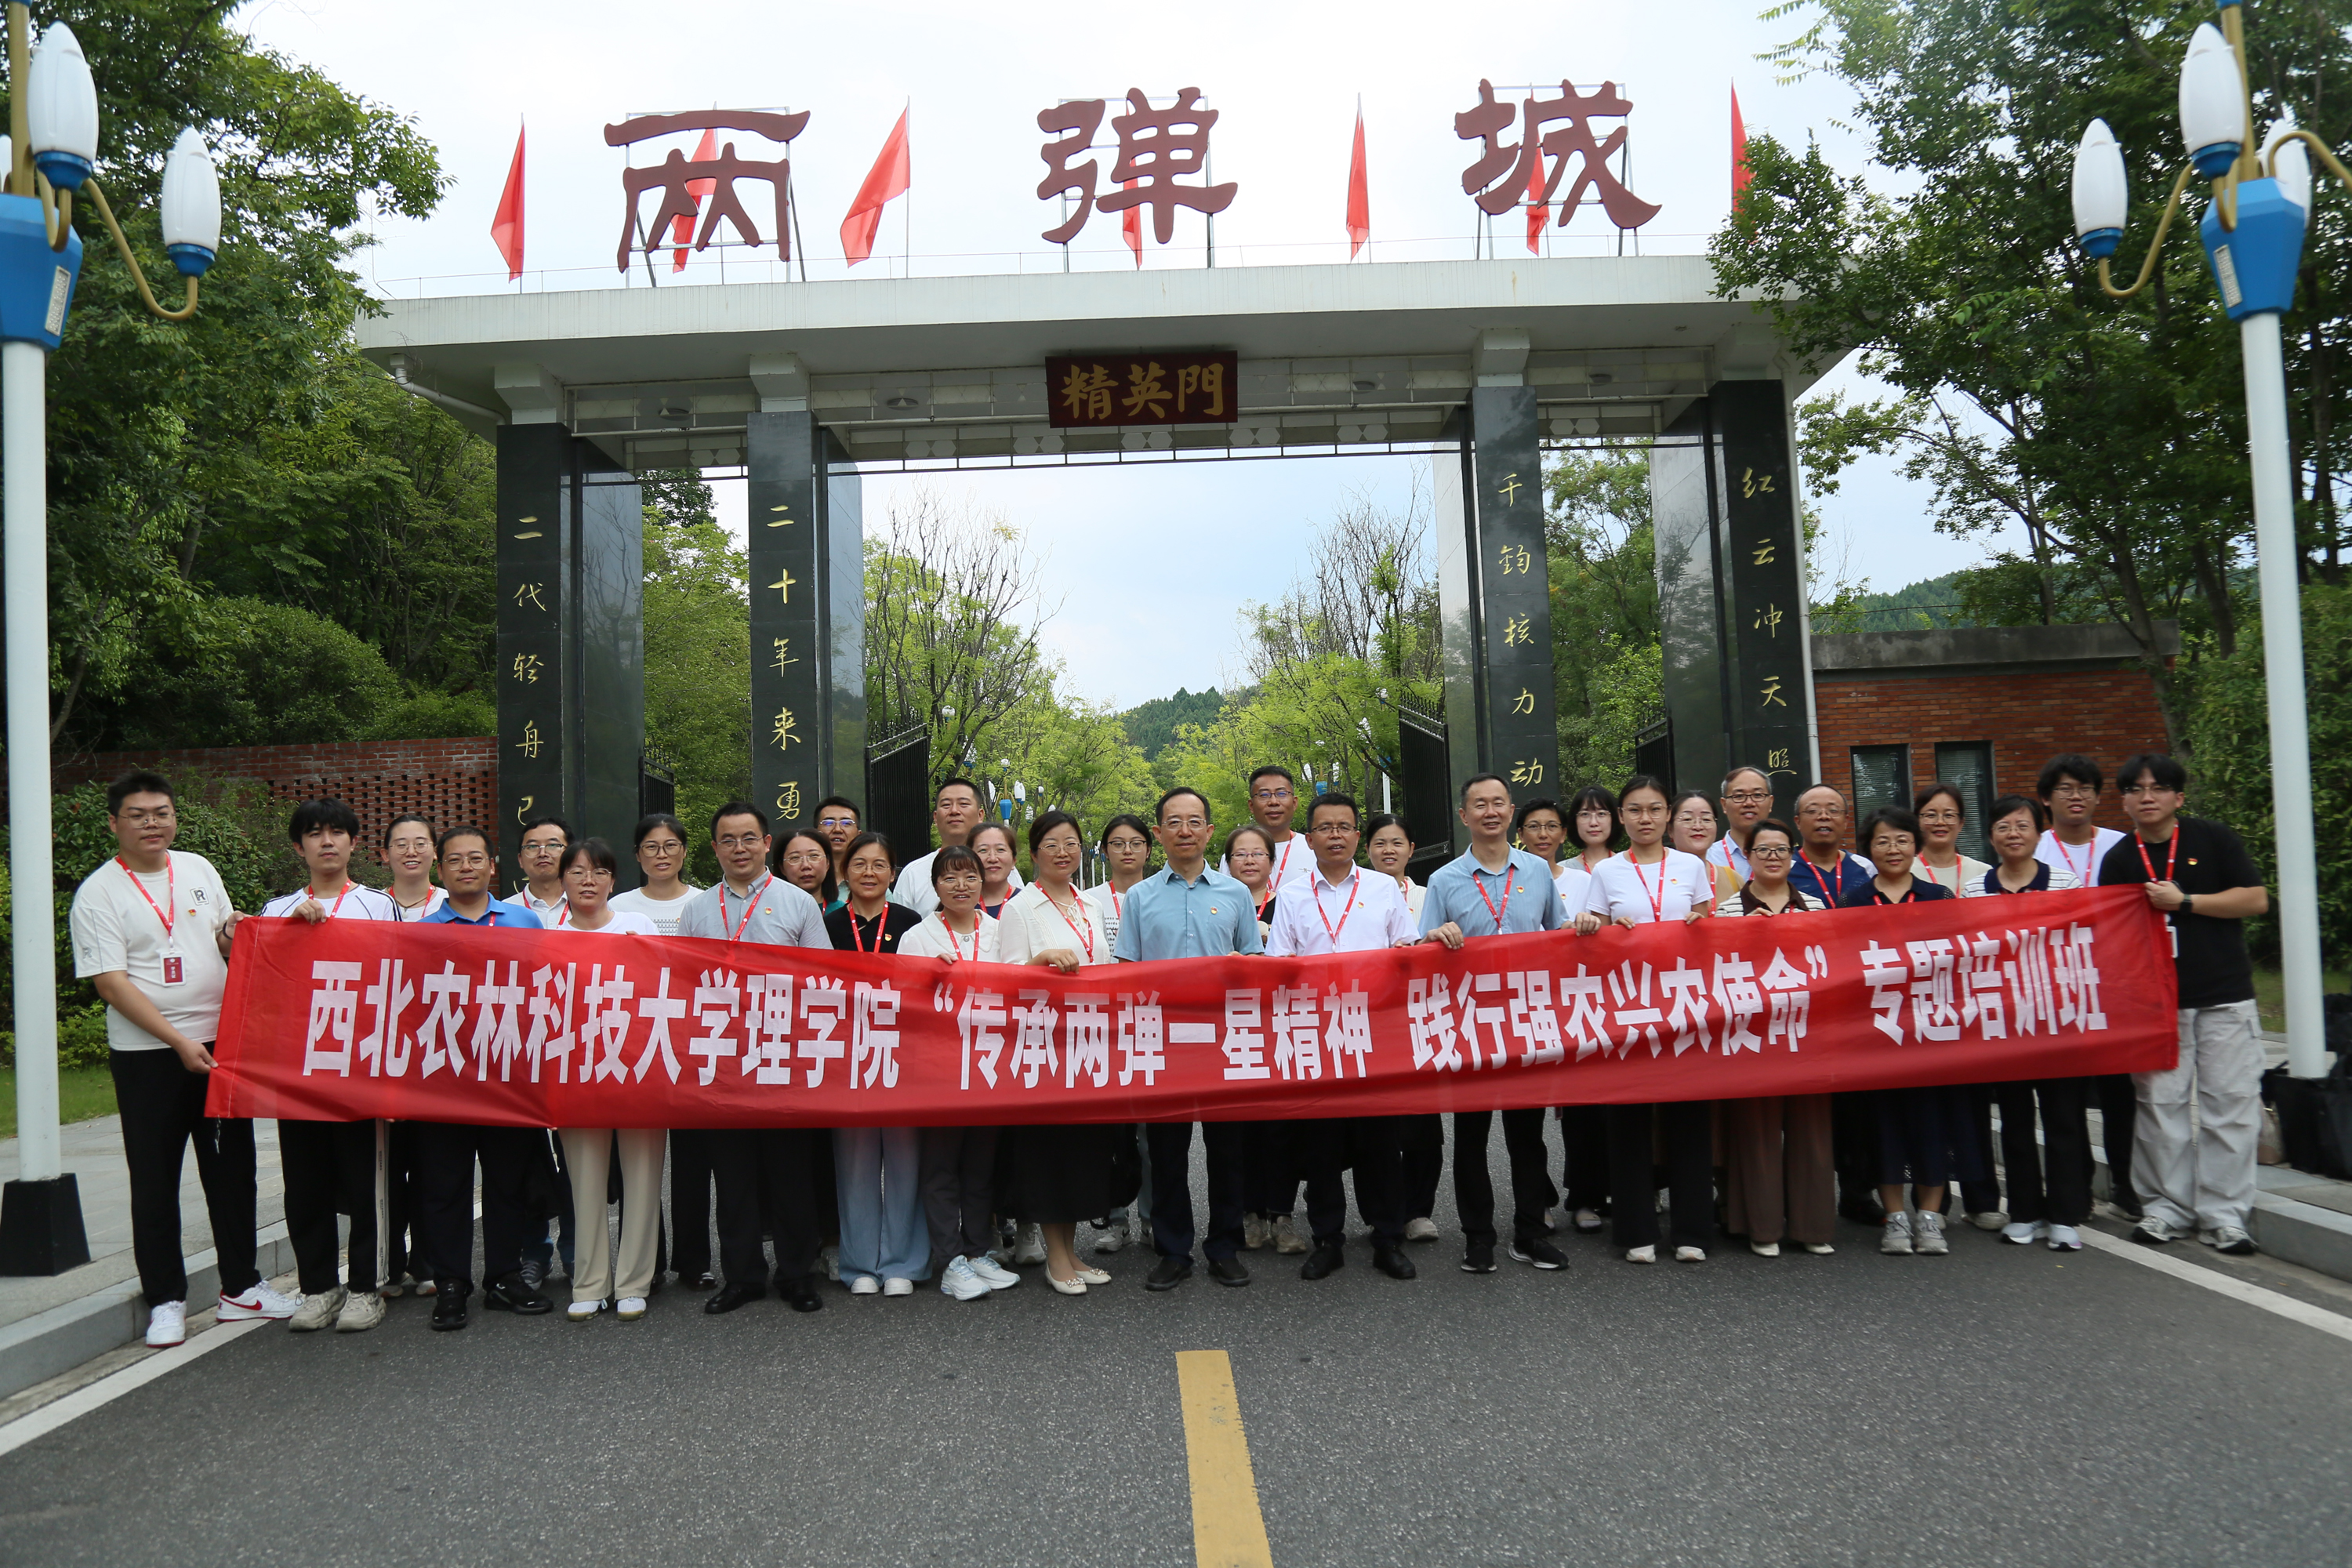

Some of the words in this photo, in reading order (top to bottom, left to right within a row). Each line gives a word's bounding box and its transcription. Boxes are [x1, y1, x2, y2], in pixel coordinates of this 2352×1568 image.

[604, 79, 1662, 273] 两弹城
[1062, 361, 1224, 419] 精英門
[513, 516, 546, 893] 二代轻舟已
[1498, 473, 1543, 851] 千钧核力动
[303, 958, 901, 1089] 西北农林科技大学理学院
[1860, 922, 2107, 1046] 专题培训班
